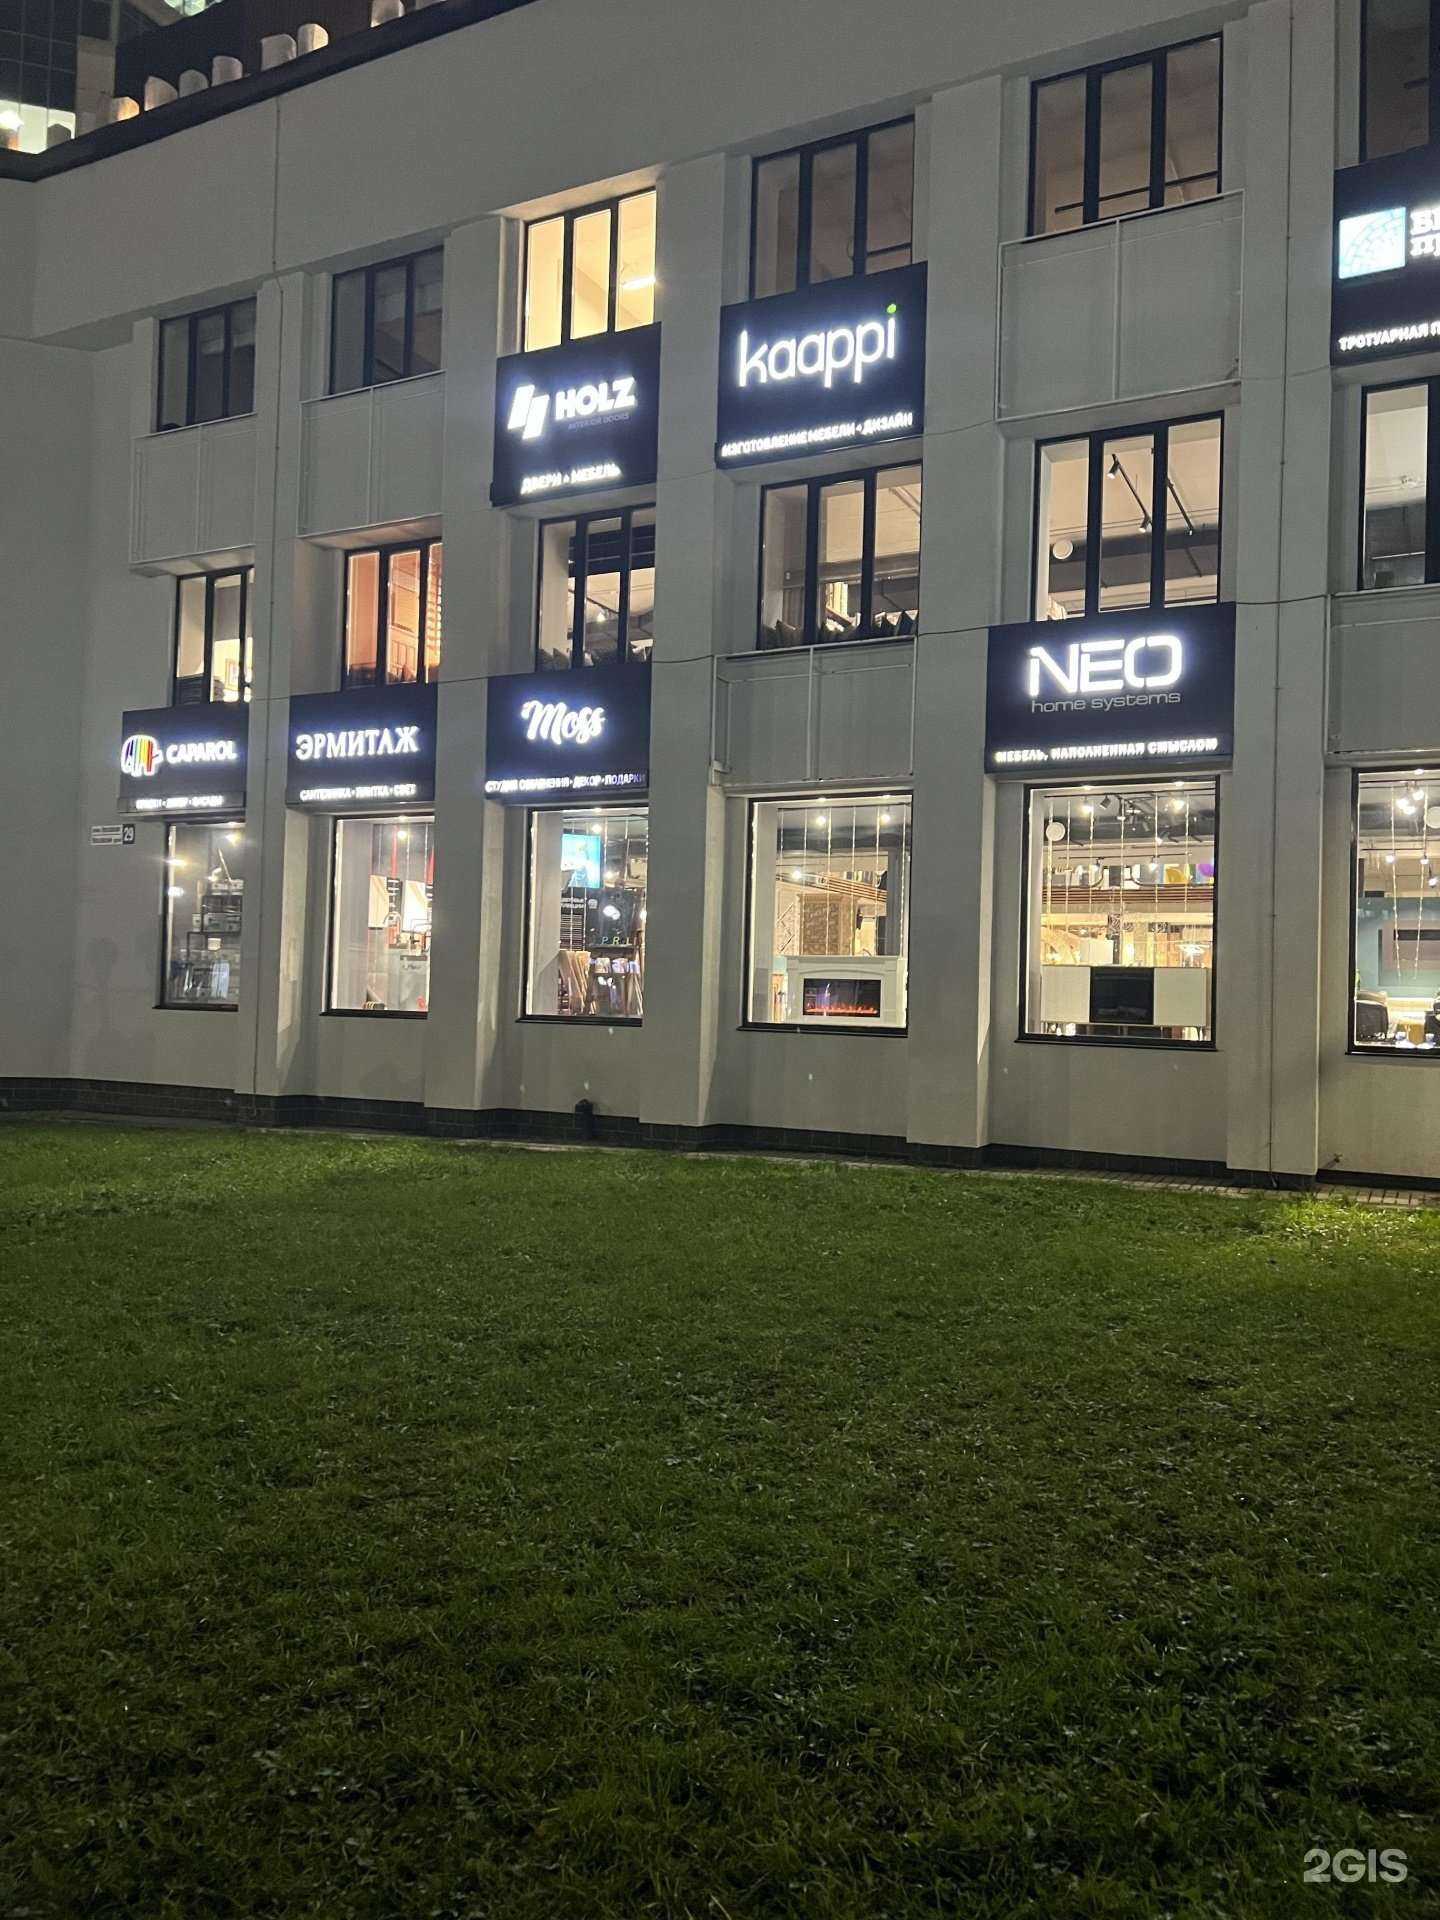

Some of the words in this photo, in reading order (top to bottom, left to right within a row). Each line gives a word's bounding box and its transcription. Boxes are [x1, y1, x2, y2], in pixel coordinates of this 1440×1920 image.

[738, 304, 897, 388] kaappi
[1338, 323, 1429, 351] ТРОТУАРНАЯ
[555, 377, 636, 421] HOLZ
[721, 432, 807, 457] ИЗГОТОВЛЕНИЕ
[807, 423, 855, 444] МЕБЕЛИ
[862, 411, 913, 434] ДИЗАЙН
[1028, 635, 1183, 697] NEO
[1032, 698, 1086, 713] home
[1091, 691, 1182, 712] systems
[520, 700, 606, 745] Moss
[165, 740, 239, 764] CAPAROL
[295, 725, 419, 760] ЭРМИТАЖ
[1051, 742, 1145, 761] НАПОЛНЕННАЯ
[1148, 737, 1218, 755] СМЫСЛОМ
[123, 827, 134, 842] 29
